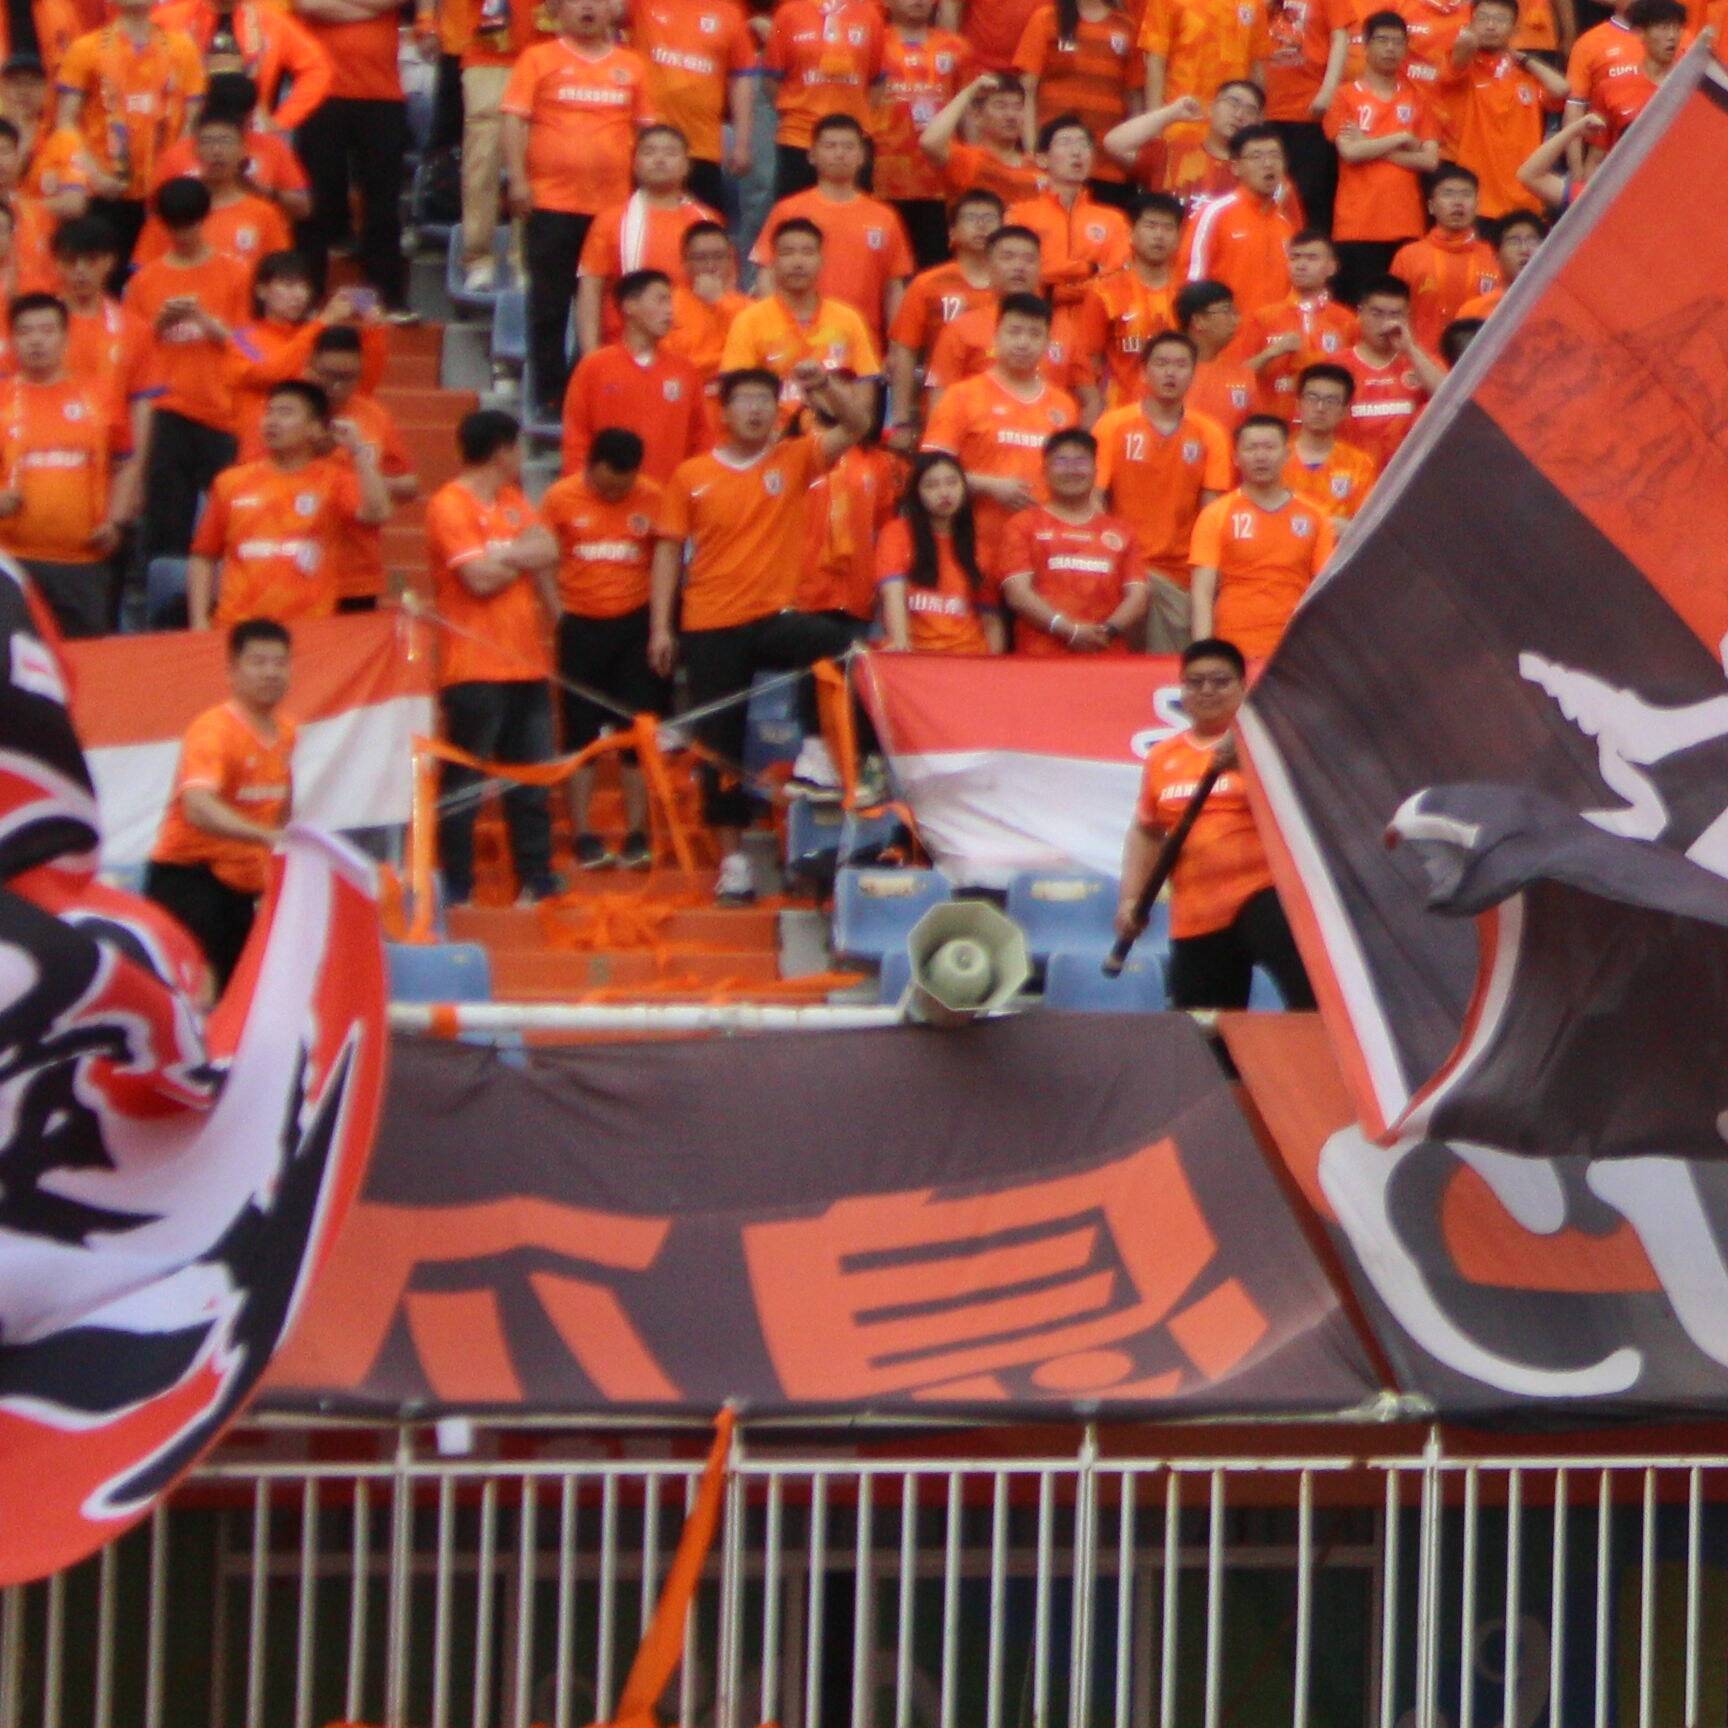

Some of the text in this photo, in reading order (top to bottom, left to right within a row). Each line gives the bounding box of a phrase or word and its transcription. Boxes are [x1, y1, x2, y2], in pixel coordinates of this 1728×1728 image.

[1357, 106, 1373, 130] 12
[941, 296, 961, 321] 12
[1351, 401, 1413, 418] SHANDONG
[1125, 435, 1144, 460] 12
[1231, 513, 1254, 539] 12
[1047, 555, 1113, 573] SHANDONG
